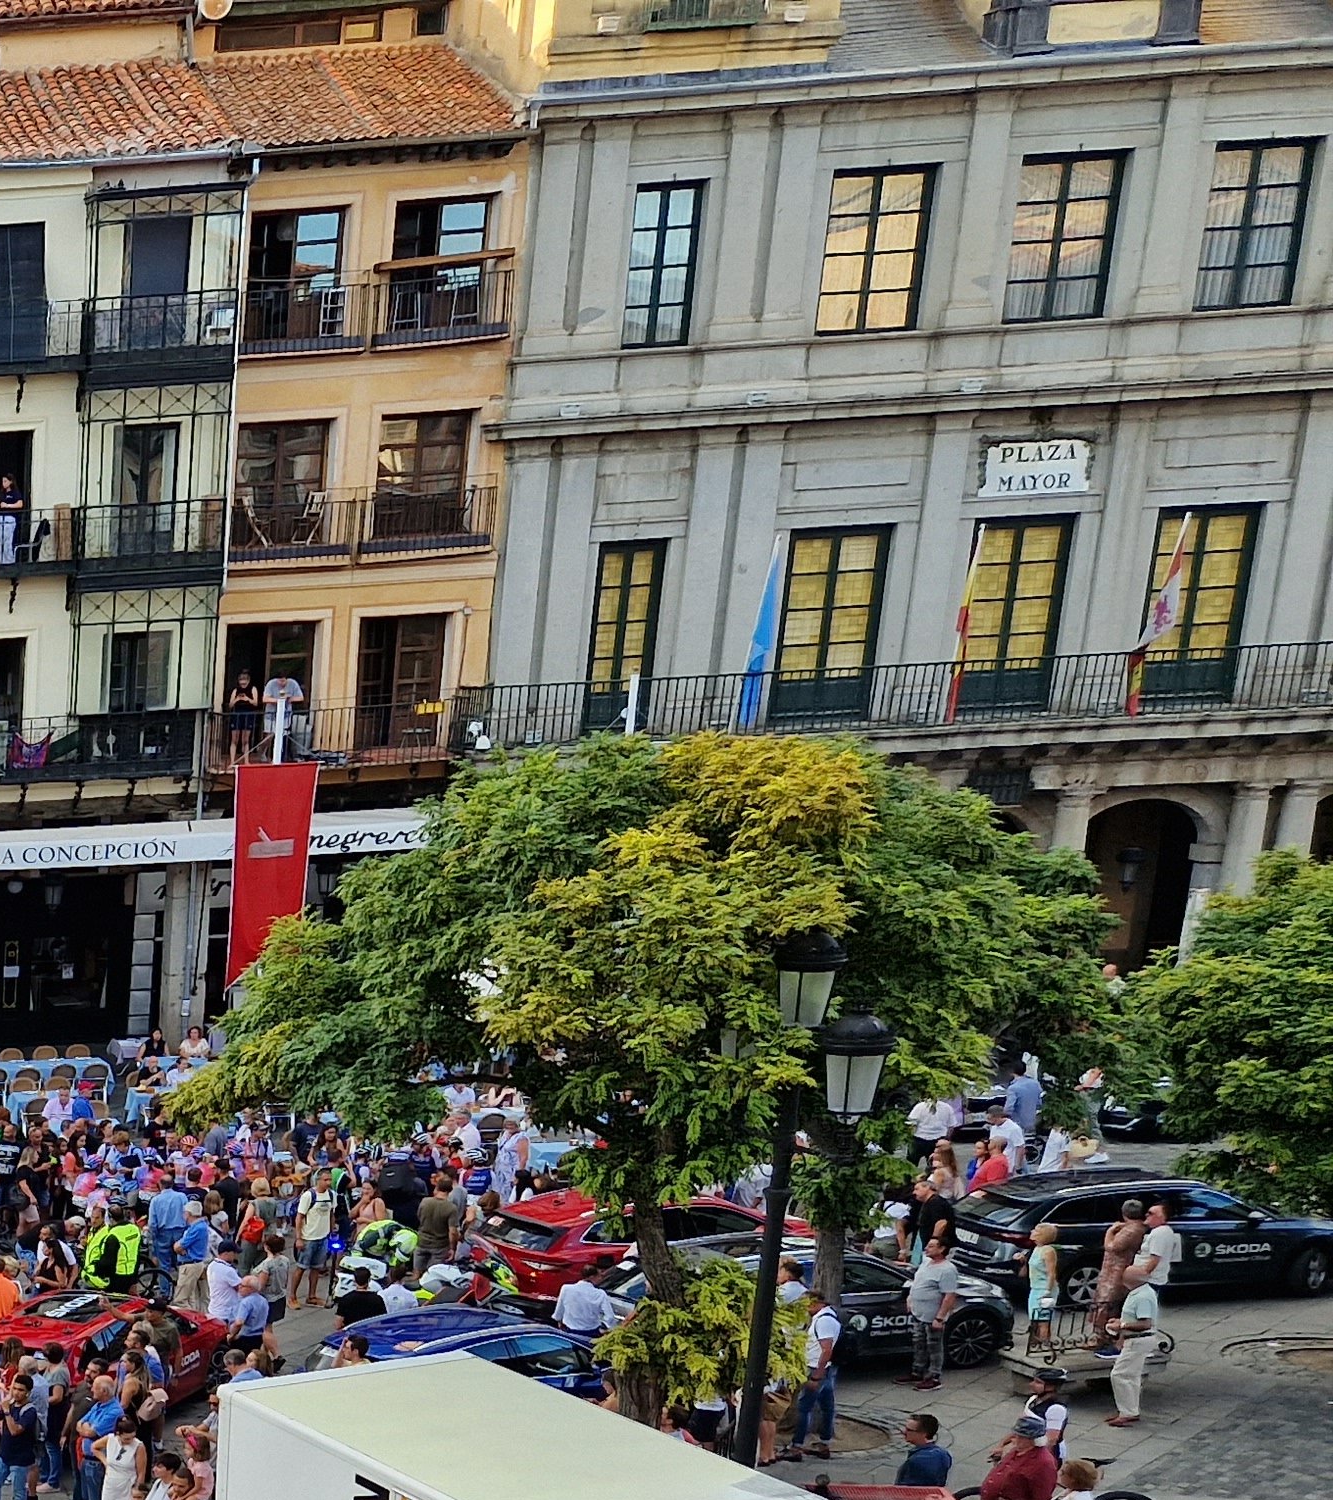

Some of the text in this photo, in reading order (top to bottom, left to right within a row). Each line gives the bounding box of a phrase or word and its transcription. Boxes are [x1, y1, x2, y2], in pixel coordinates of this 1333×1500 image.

[998, 443, 1077, 463] PLAZA
[997, 472, 1071, 492] MAYOR
[21, 838, 179, 865] CONCEPCIÓN
[1215, 1242, 1272, 1255] ŠKODA
